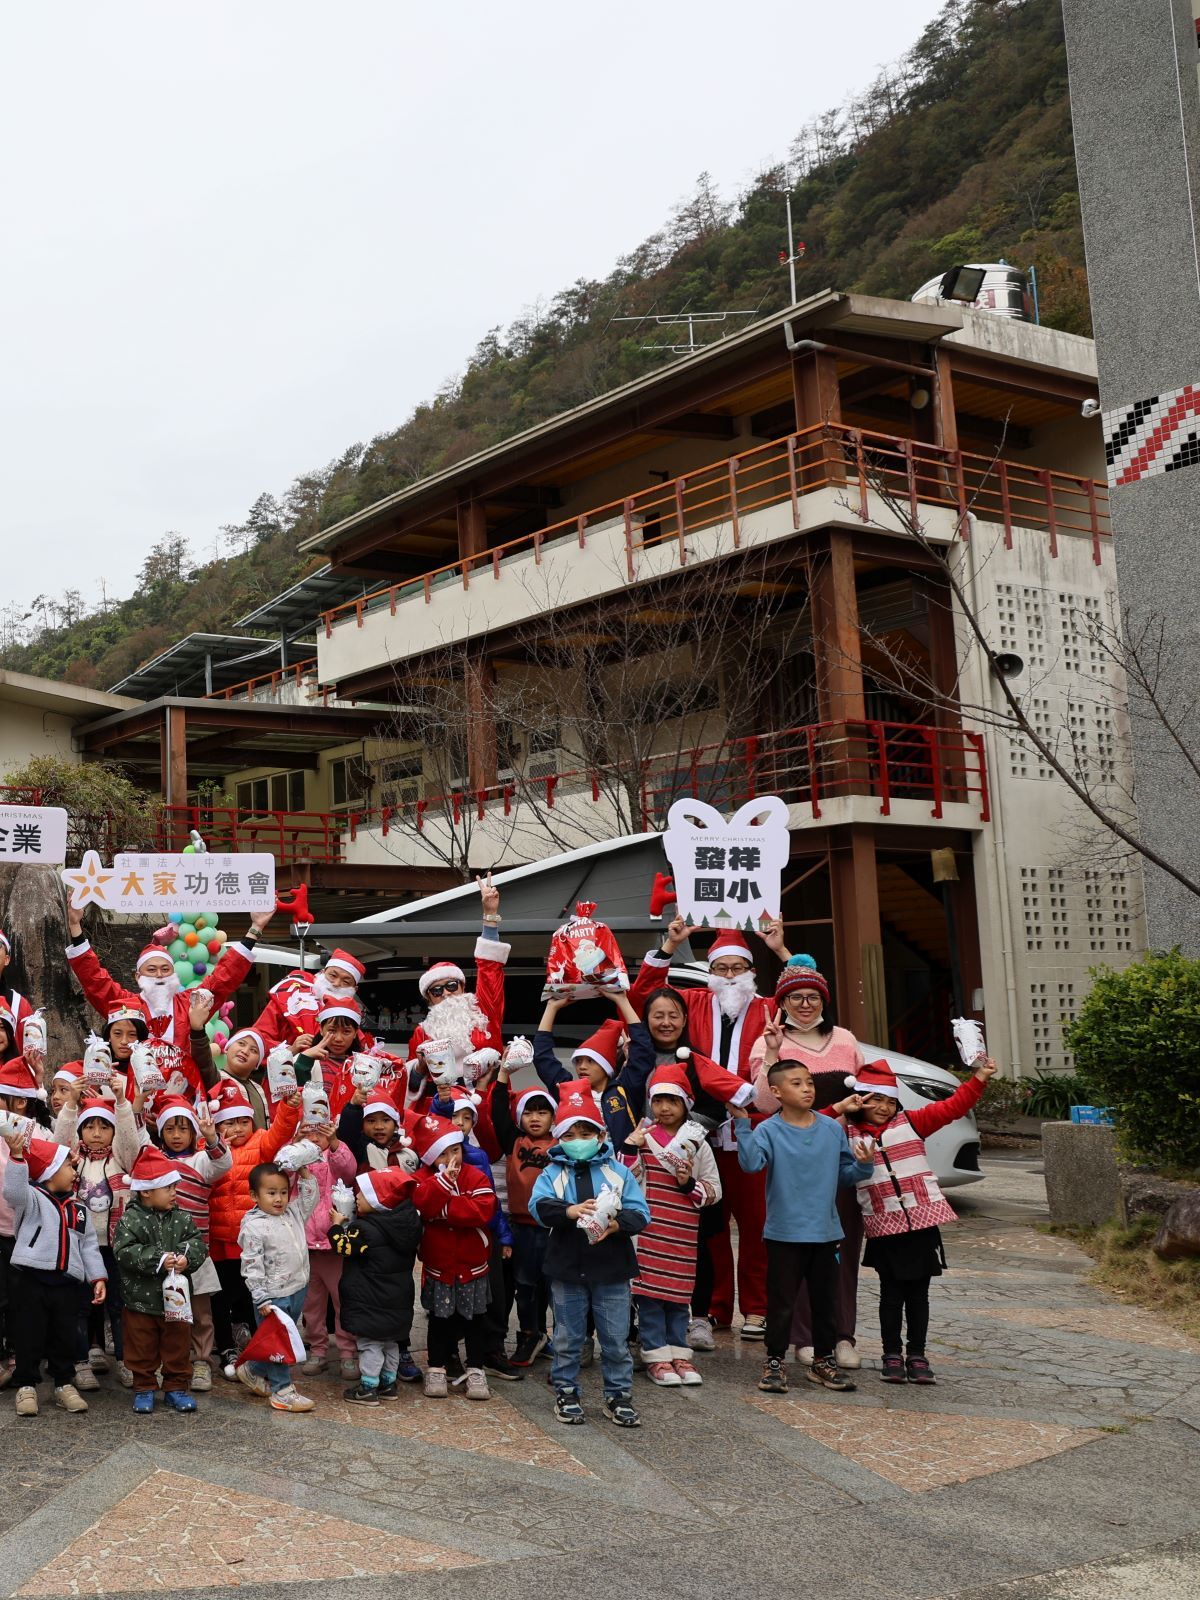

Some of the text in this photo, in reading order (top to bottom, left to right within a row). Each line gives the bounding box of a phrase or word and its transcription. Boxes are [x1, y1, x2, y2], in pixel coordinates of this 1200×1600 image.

[694, 846, 761, 872] 發祥
[120, 871, 270, 896] 大家功德會
[694, 877, 762, 903] 國小
[569, 927, 595, 939] PARTY
